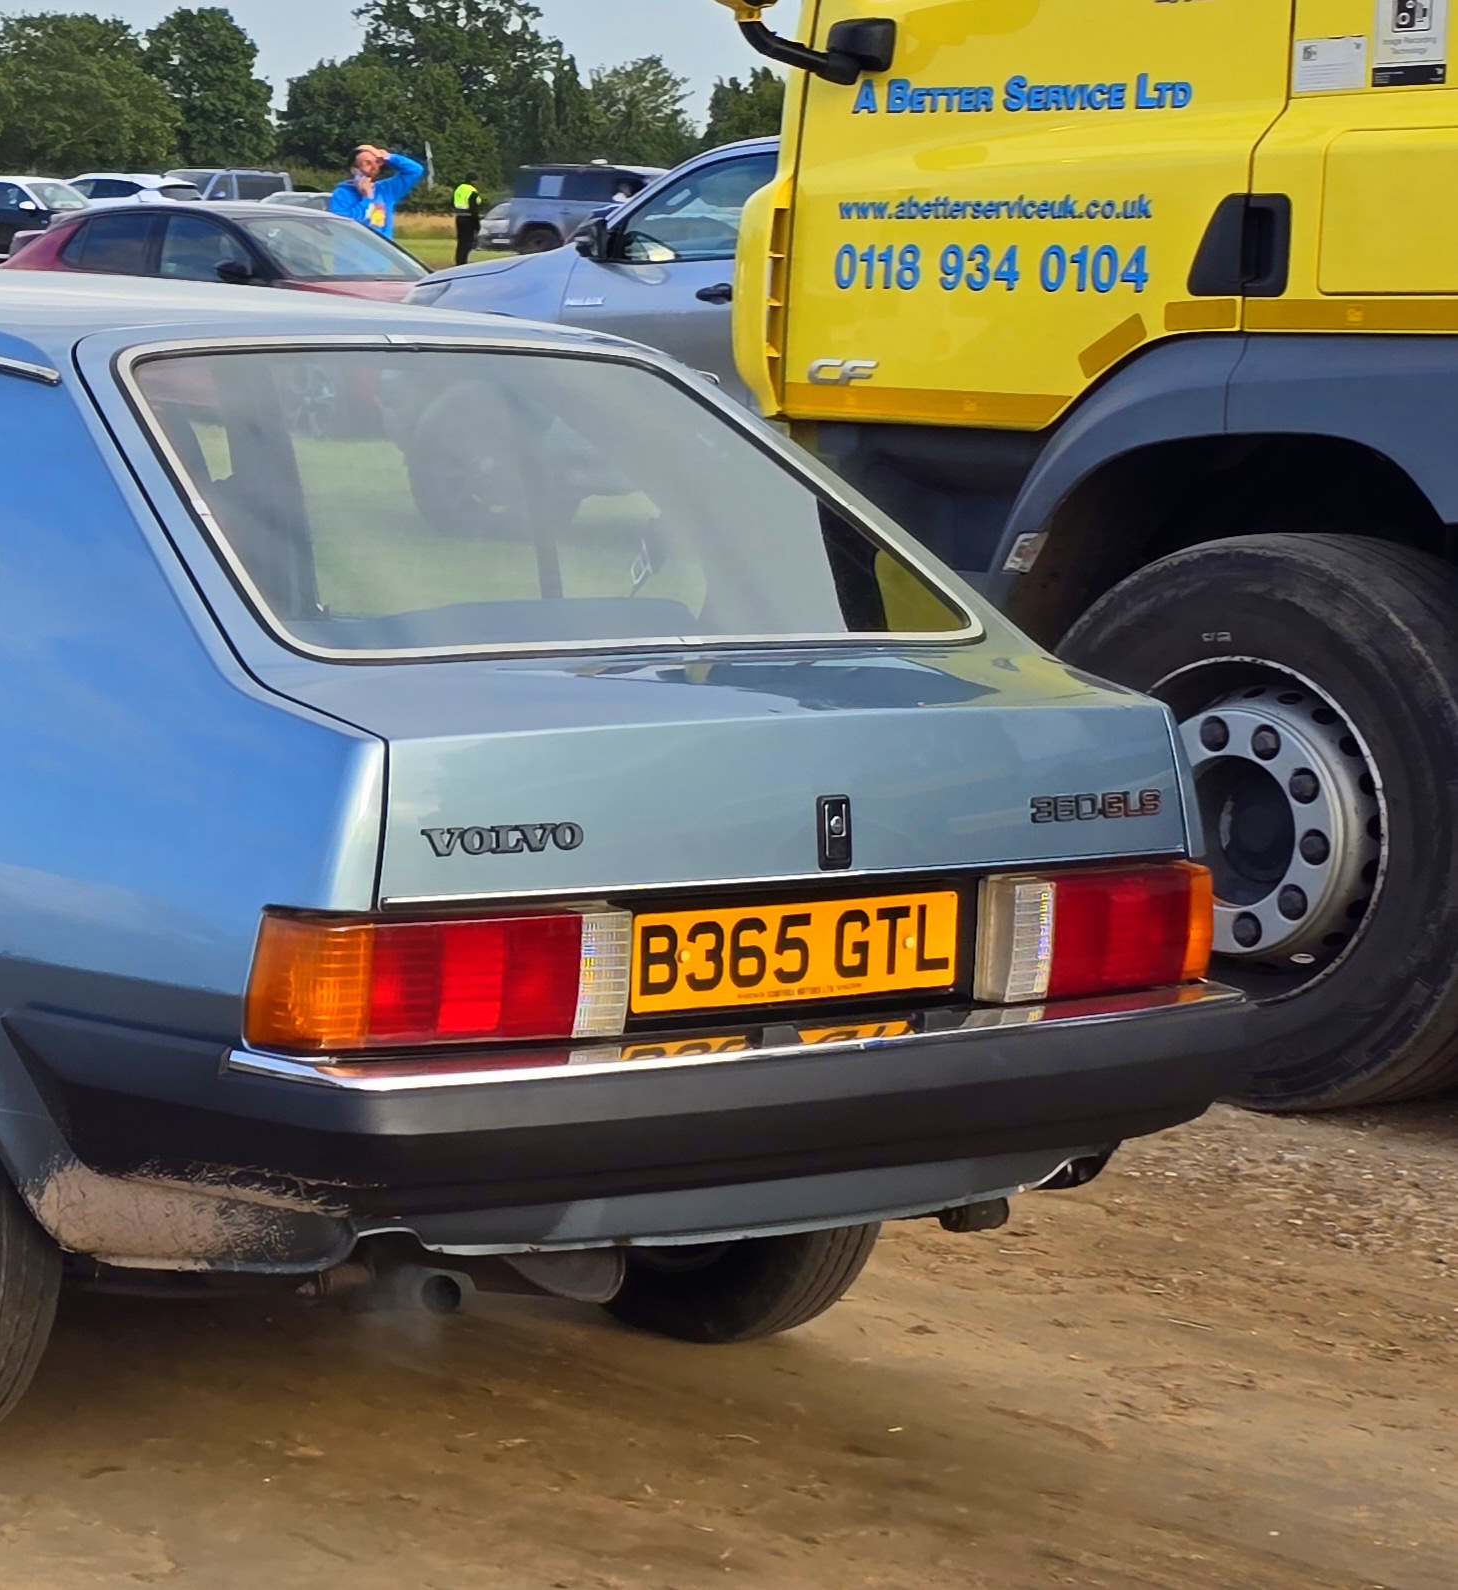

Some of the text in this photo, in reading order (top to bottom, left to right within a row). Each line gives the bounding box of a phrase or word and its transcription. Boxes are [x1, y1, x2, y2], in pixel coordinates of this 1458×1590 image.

[851, 79, 877, 114] A
[838, 194, 1153, 219] www.abetterserviceuk.co.uk
[834, 243, 1149, 293] 0118 934 0104
[808, 358, 879, 386] CF
[421, 822, 584, 857] VOLVO
[639, 904, 950, 997] B365 GTL
